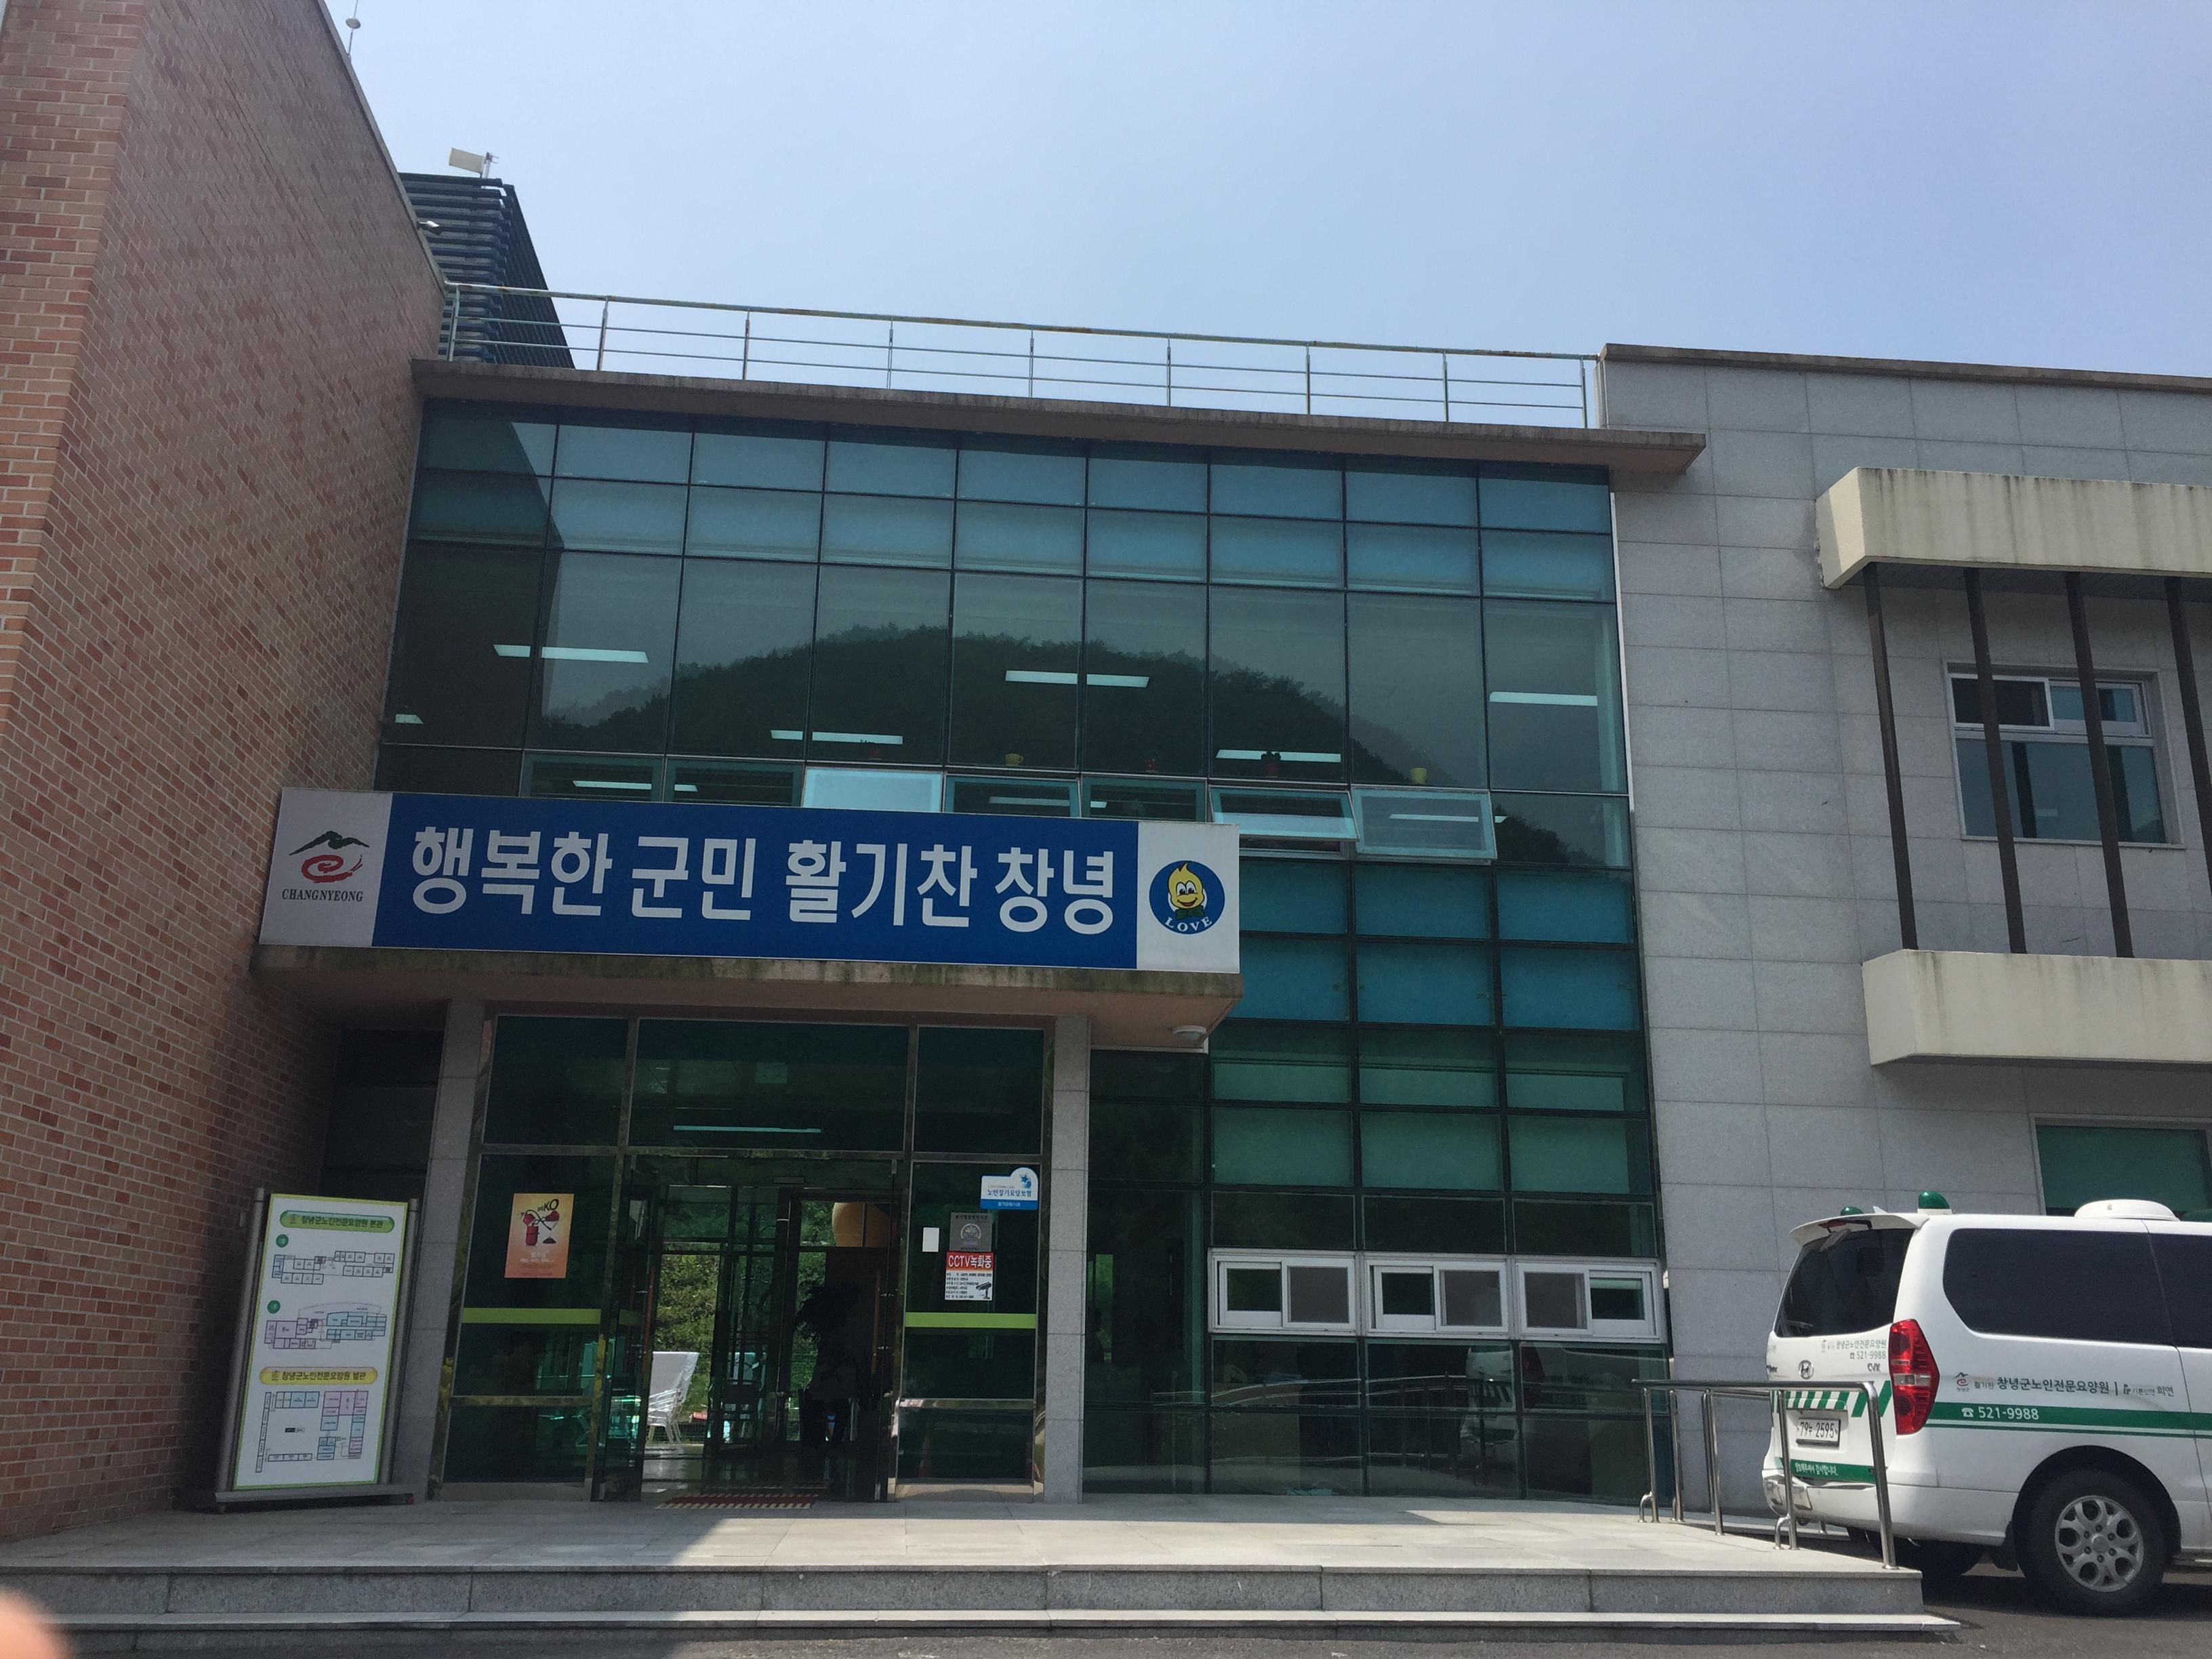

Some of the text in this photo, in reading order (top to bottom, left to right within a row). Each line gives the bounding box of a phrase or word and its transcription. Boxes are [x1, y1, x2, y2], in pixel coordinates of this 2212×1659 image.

[412, 826, 1114, 935] 행복한 군민 활기찬 창녕
[282, 888, 363, 902] CHANGNYEONG
[1165, 916, 1212, 932] LOVE
[948, 1254, 992, 1269] CCTV녹화중
[1856, 1351, 1887, 1359] 521-9988
[1996, 1376, 2110, 1395] 창녕군노인전문요양원
[1978, 1406, 2039, 1420] 521-9988
[1816, 1422, 1835, 1439] 2595
